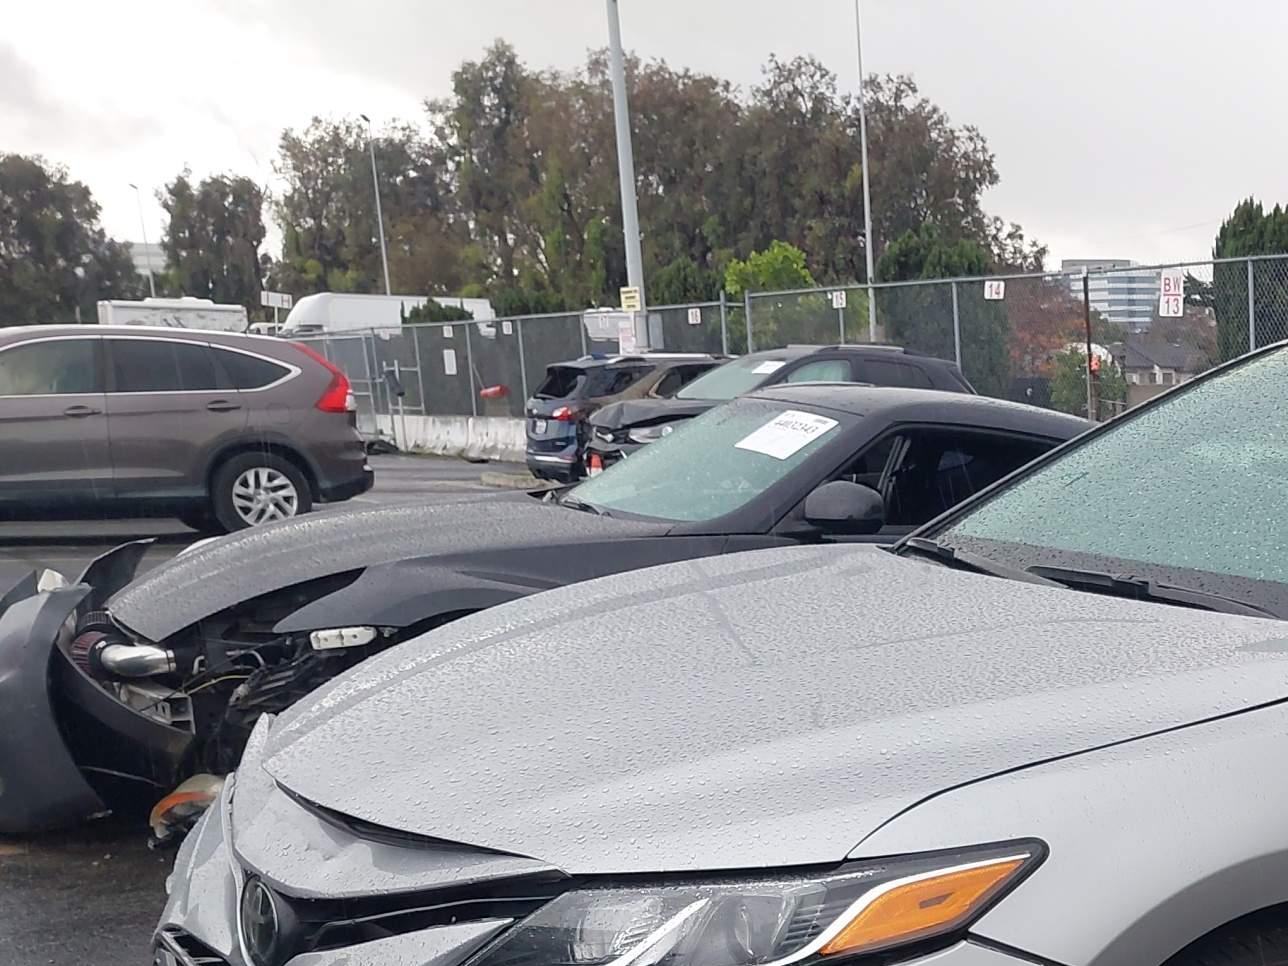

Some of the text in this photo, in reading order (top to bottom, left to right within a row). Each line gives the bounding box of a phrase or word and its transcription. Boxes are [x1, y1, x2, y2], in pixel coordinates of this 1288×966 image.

[987, 282, 1001, 298] 14
[1163, 276, 1182, 293] BW
[1164, 297, 1180, 315] 13
